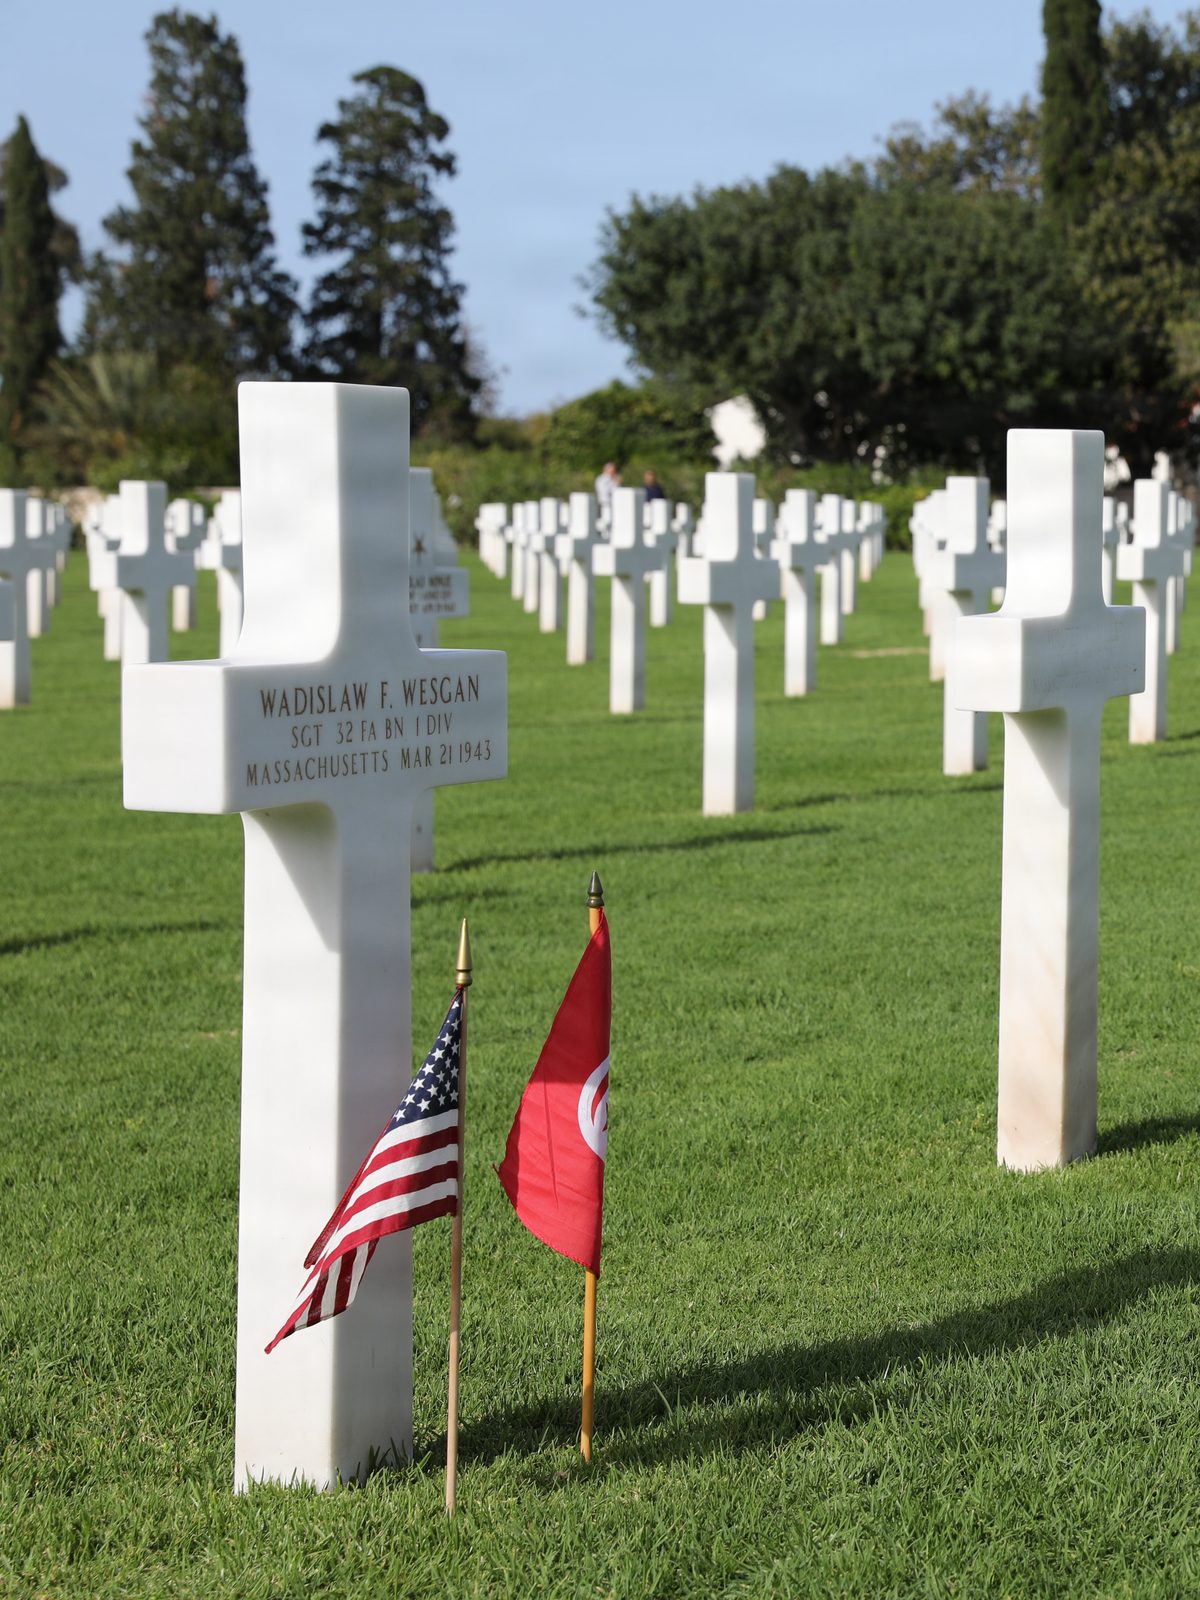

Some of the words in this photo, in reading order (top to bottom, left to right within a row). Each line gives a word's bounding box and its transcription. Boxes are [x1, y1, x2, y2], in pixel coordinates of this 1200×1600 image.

[260, 683, 368, 717] WADISLAW
[380, 681, 393, 709] F.
[402, 675, 480, 706] WESGAN
[291, 724, 323, 749] SGT
[336, 722, 353, 744] 32
[361, 720, 377, 742] FA
[385, 717, 404, 739] BN
[427, 713, 453, 735] DIV
[246, 750, 389, 787] MASSACHUSETTS
[401, 746, 432, 770] MAR
[440, 744, 452, 765] 21
[459, 740, 492, 763] 1943
